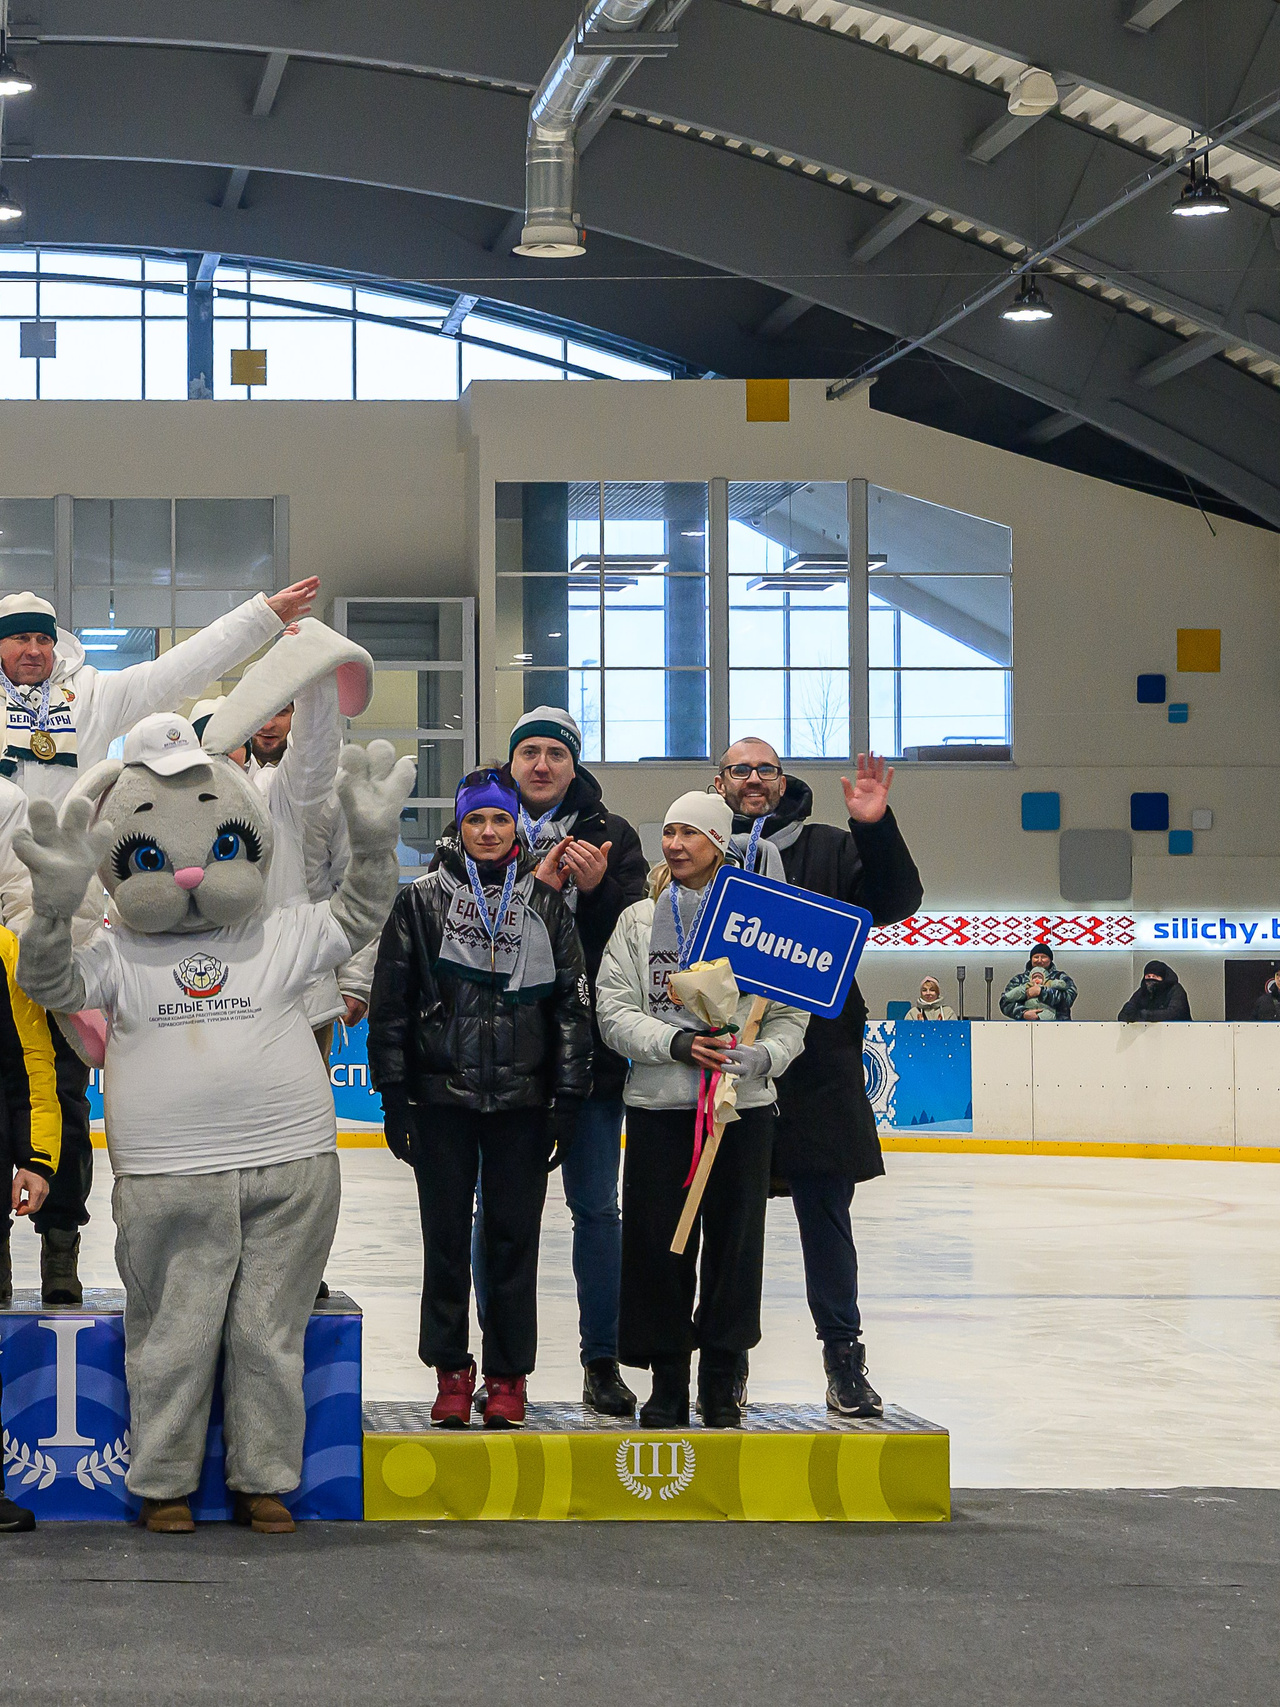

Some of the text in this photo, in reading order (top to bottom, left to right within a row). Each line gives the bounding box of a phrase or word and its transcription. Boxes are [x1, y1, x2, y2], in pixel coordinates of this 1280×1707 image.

[722, 911, 833, 973] Единые
[158, 997, 251, 1015] БЕЛЫЕ ТИГРЫ
